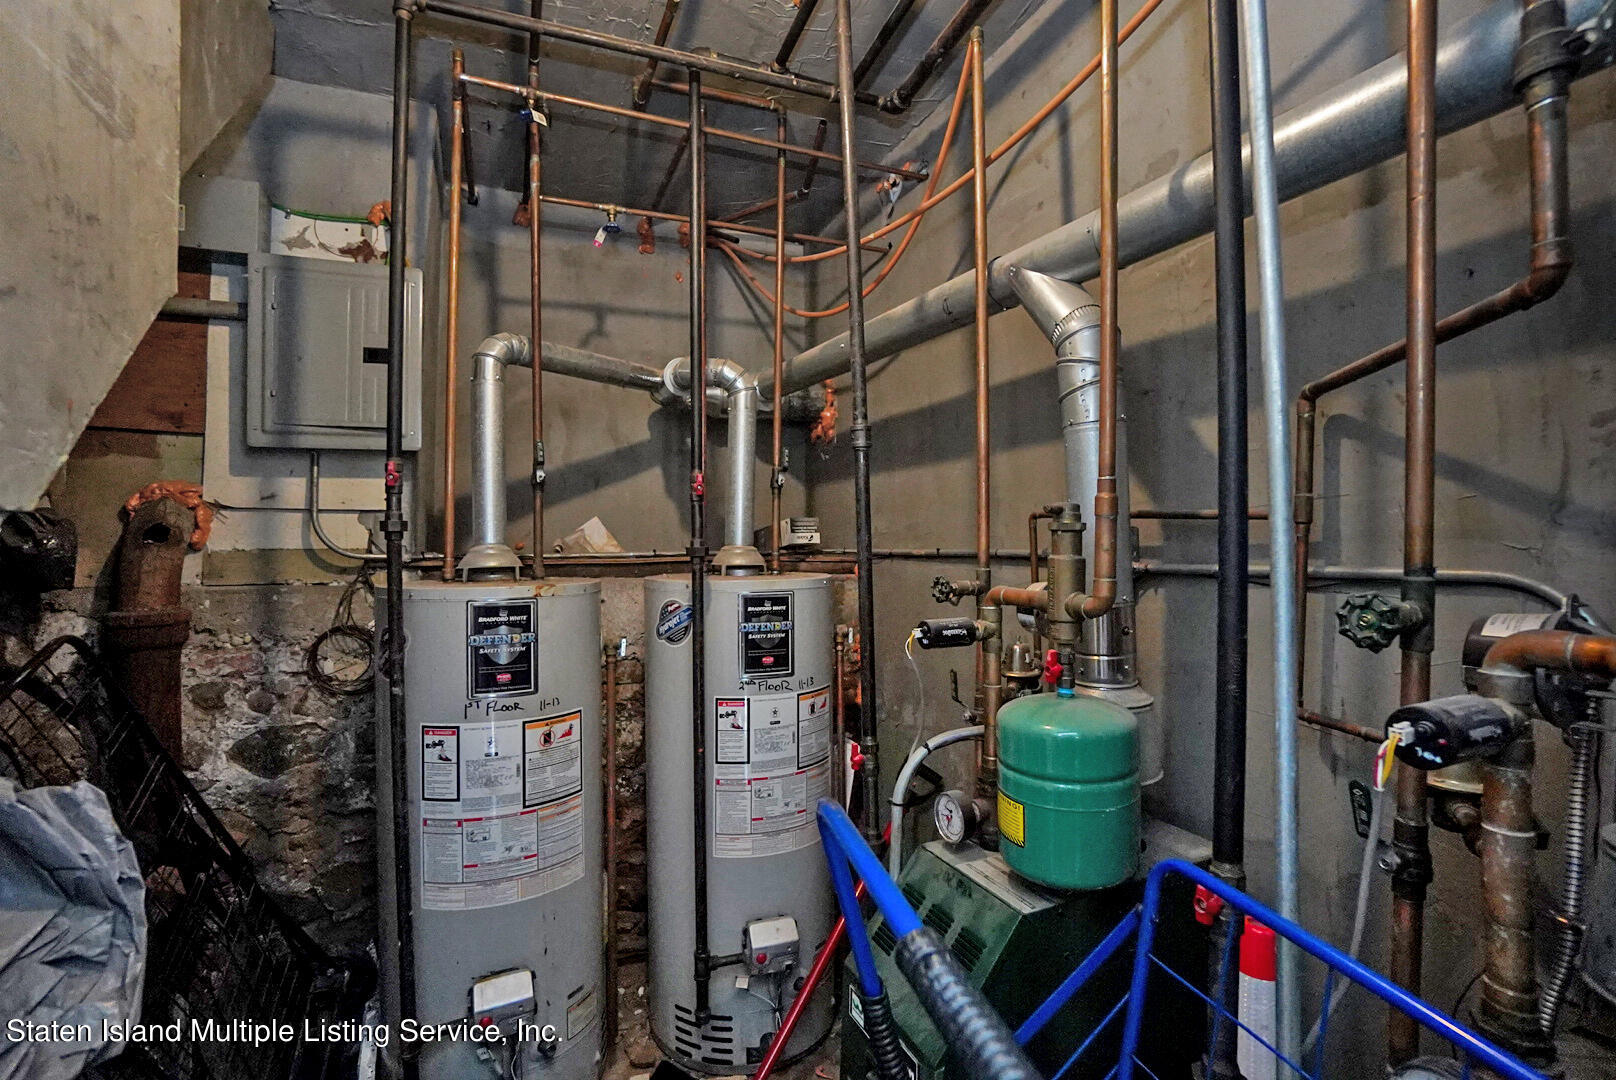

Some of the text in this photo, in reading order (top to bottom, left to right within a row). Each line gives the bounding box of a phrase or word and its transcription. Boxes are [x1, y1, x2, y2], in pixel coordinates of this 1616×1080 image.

[740, 621, 793, 632] DEFENDER
[469, 632, 536, 646] DEFENDER
[486, 700, 525, 716] FLOOR
